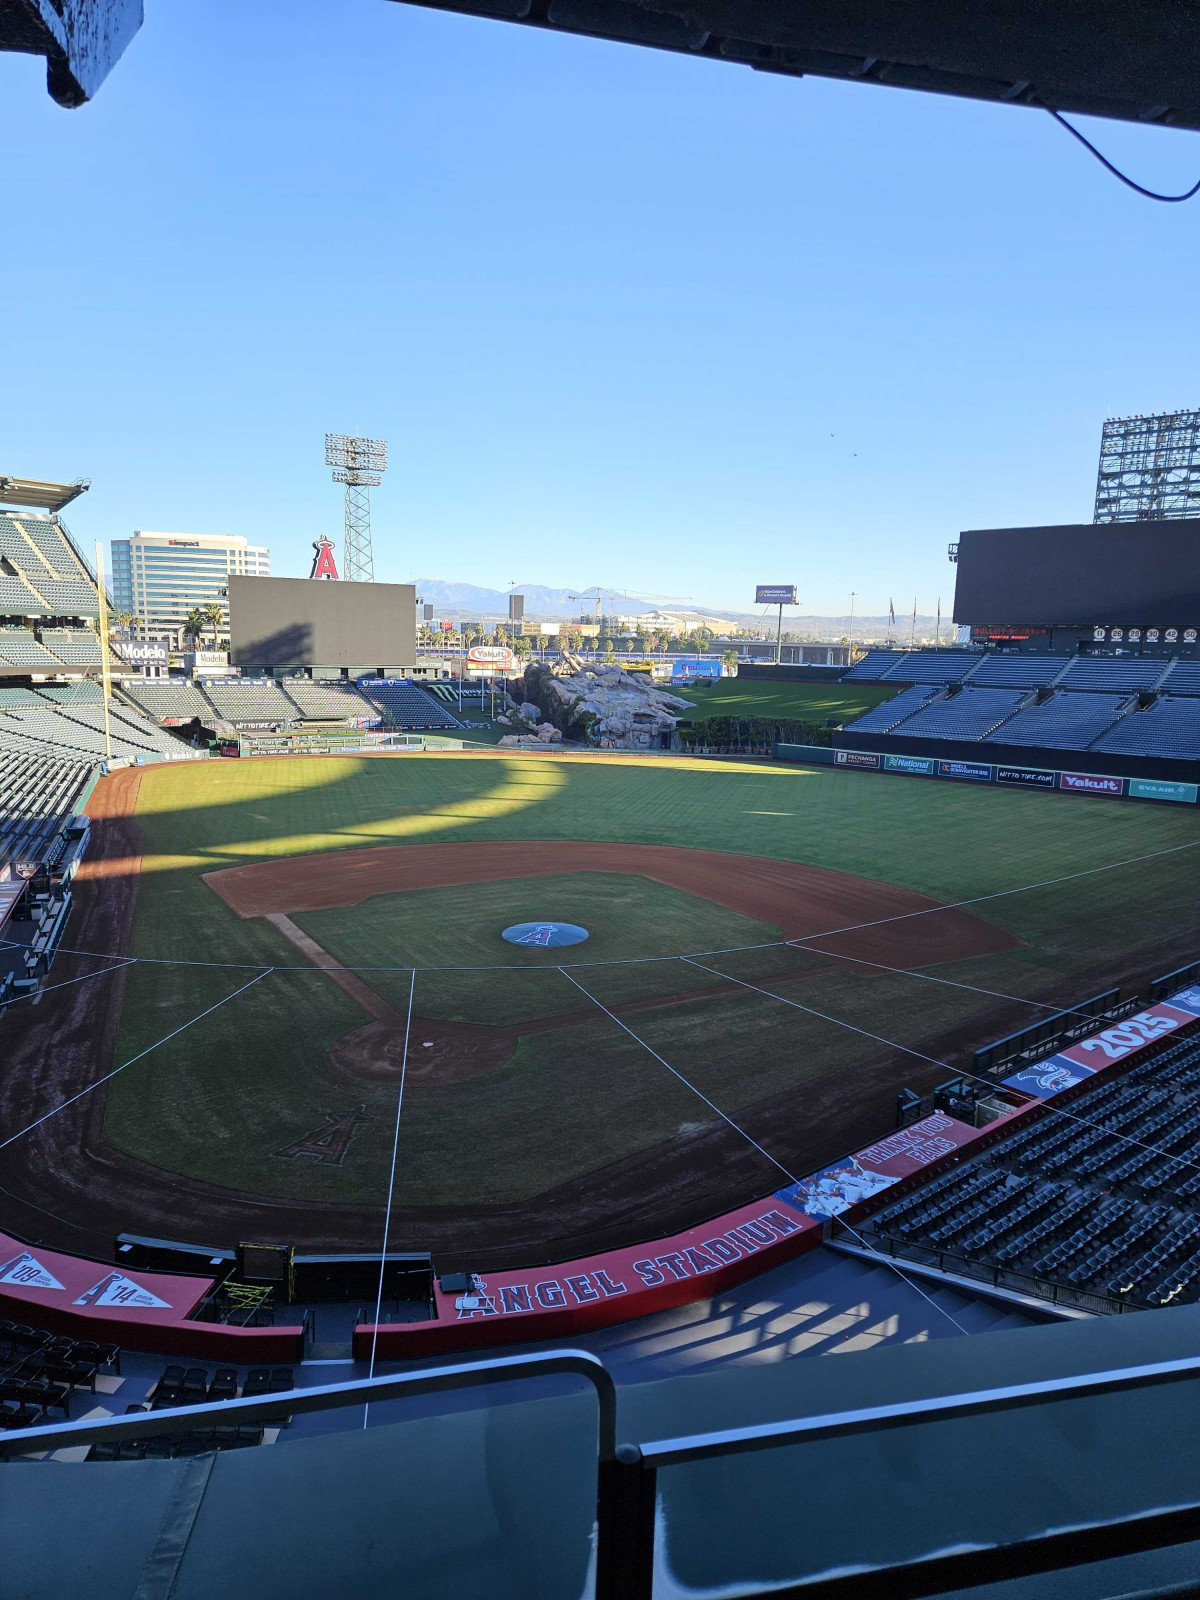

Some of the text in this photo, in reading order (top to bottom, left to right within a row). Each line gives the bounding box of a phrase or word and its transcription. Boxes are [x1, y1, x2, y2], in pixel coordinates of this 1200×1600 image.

[121, 643, 166, 660] Modelo
[200, 653, 226, 664] Modelo
[477, 650, 507, 658] Yakult
[897, 759, 930, 769] National
[1065, 776, 1119, 791] Yakult
[1081, 1012, 1179, 1059] 2025
[857, 1115, 955, 1165] THANK YOU
[906, 1137, 957, 1165] FANS
[632, 1209, 803, 1287] STADIUM
[109, 1285, 138, 1304] '14
